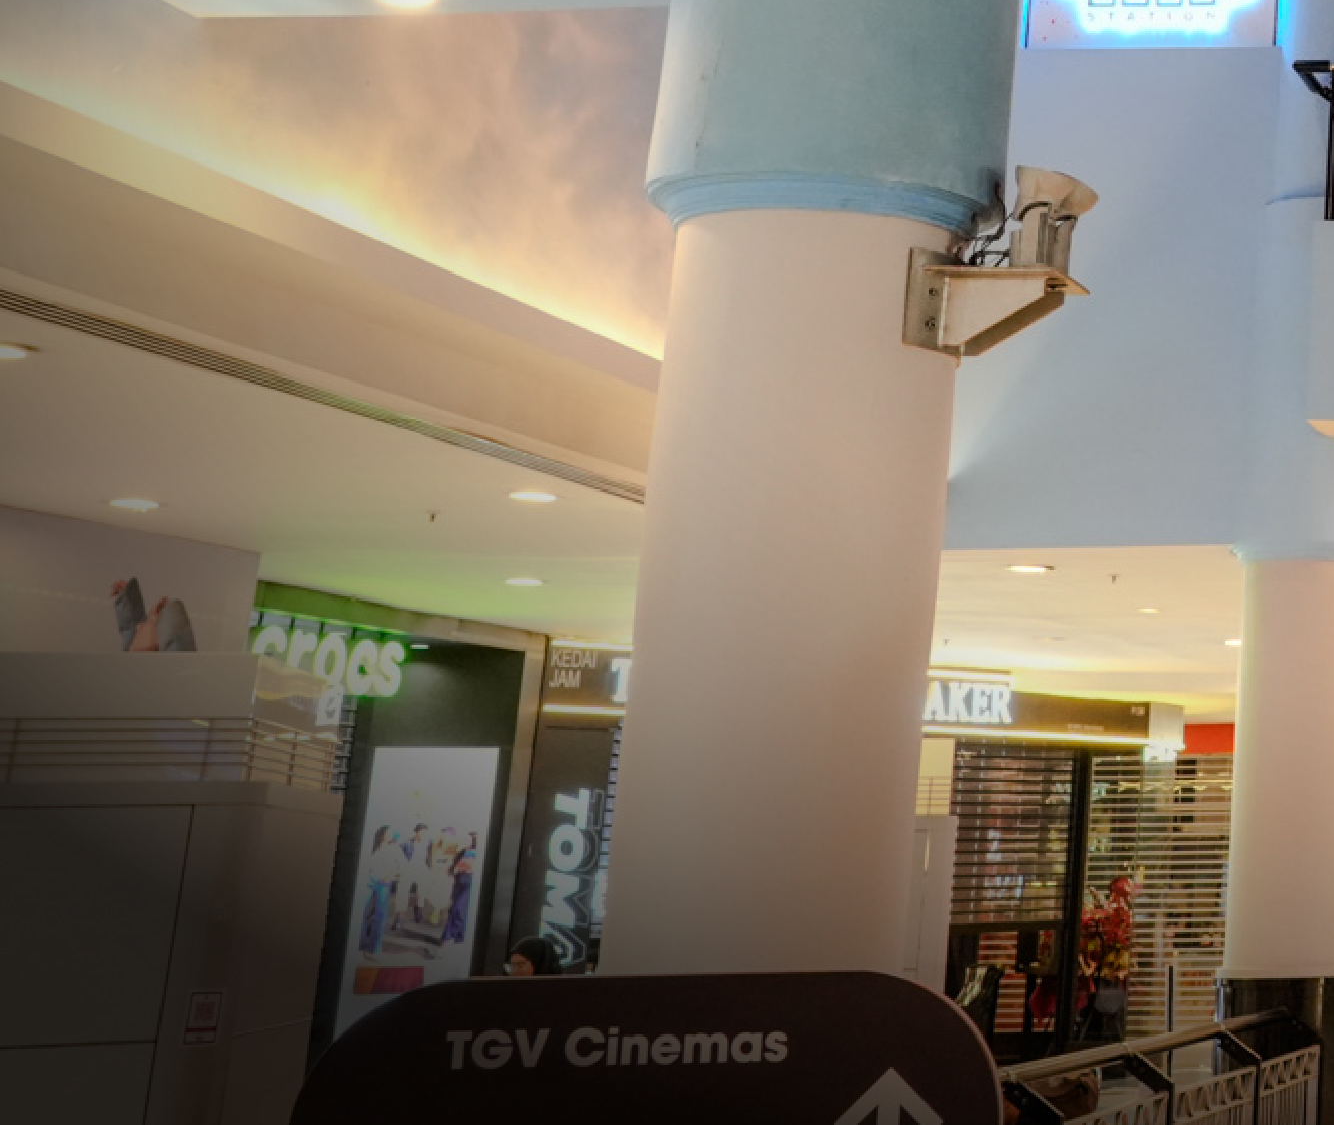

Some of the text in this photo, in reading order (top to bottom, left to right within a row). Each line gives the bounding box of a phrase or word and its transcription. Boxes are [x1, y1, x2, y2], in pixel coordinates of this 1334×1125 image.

[550, 648, 598, 669] KEDAI
[548, 668, 582, 689] JAM
[445, 1025, 789, 1071] TGV Cinemas
